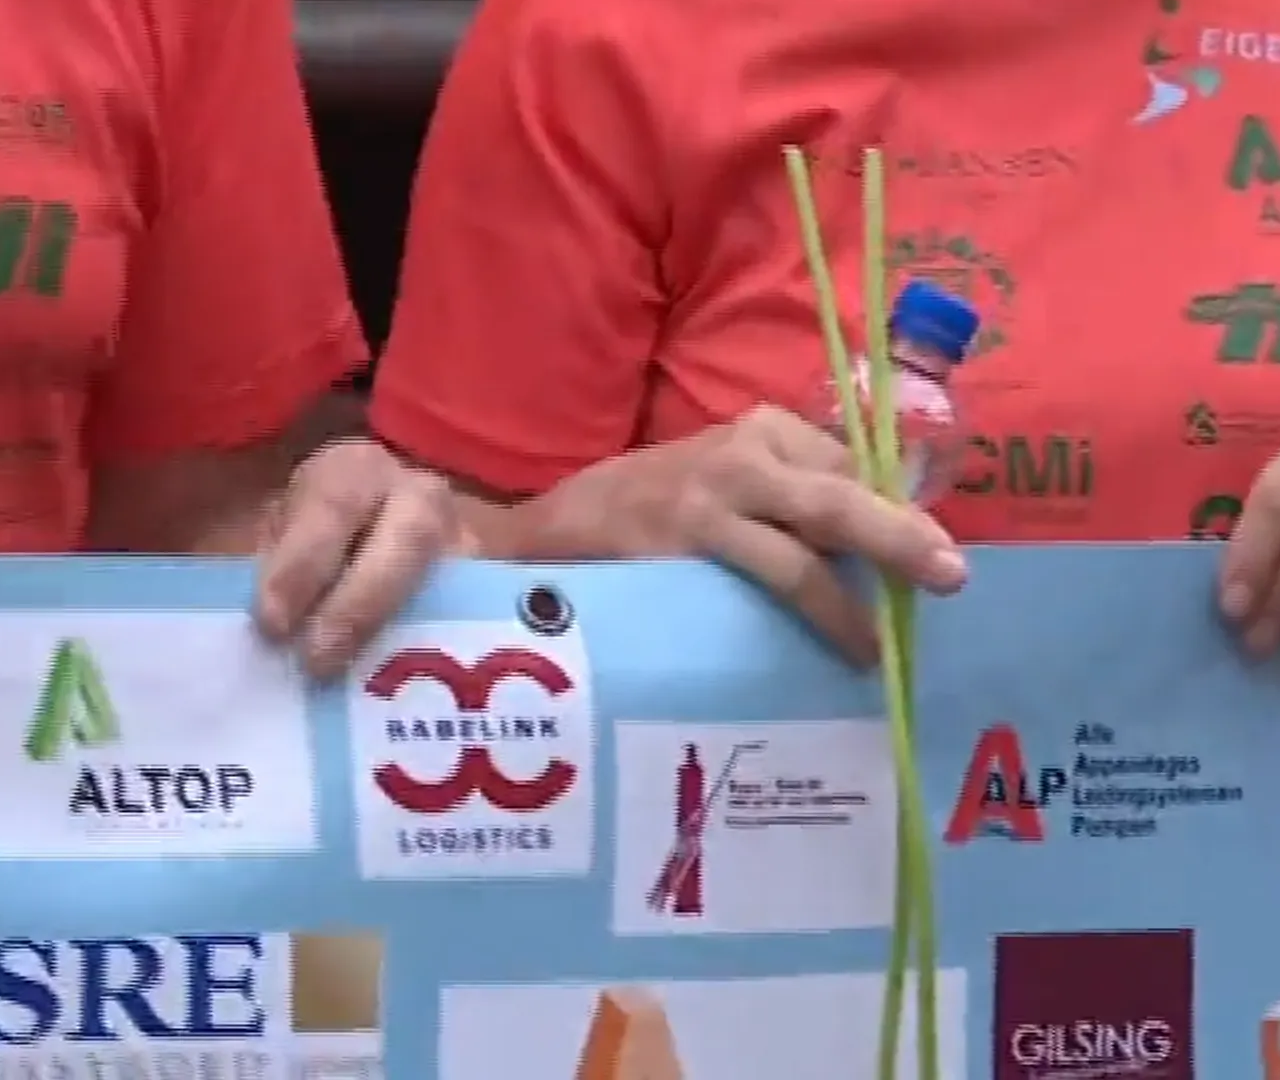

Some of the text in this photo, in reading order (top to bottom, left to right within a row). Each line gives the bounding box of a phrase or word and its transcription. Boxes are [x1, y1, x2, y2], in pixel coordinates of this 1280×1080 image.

[956, 434, 1096, 498] CMi
[385, 717, 560, 741] RABELINK
[69, 764, 256, 815] ALTOP
[1010, 1017, 1175, 1067] GILSING
